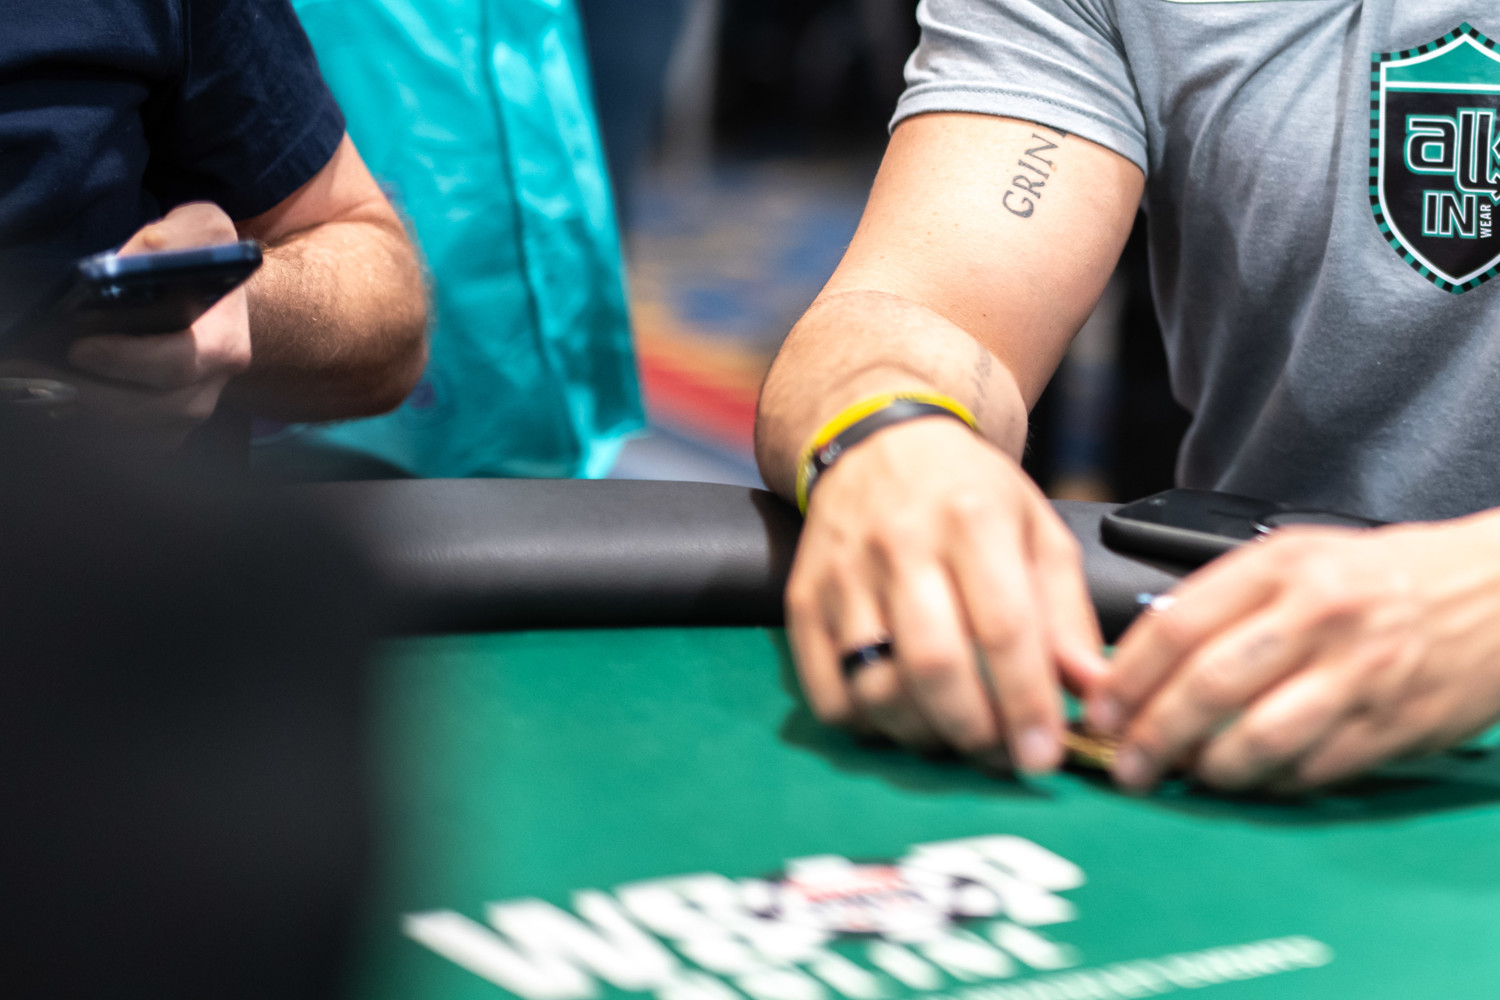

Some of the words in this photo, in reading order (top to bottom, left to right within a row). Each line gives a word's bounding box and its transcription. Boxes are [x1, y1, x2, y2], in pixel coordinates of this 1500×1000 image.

[1001, 126, 1068, 219] GRIN
[1421, 189, 1478, 240] IN
[1479, 203, 1493, 239] WEAR
